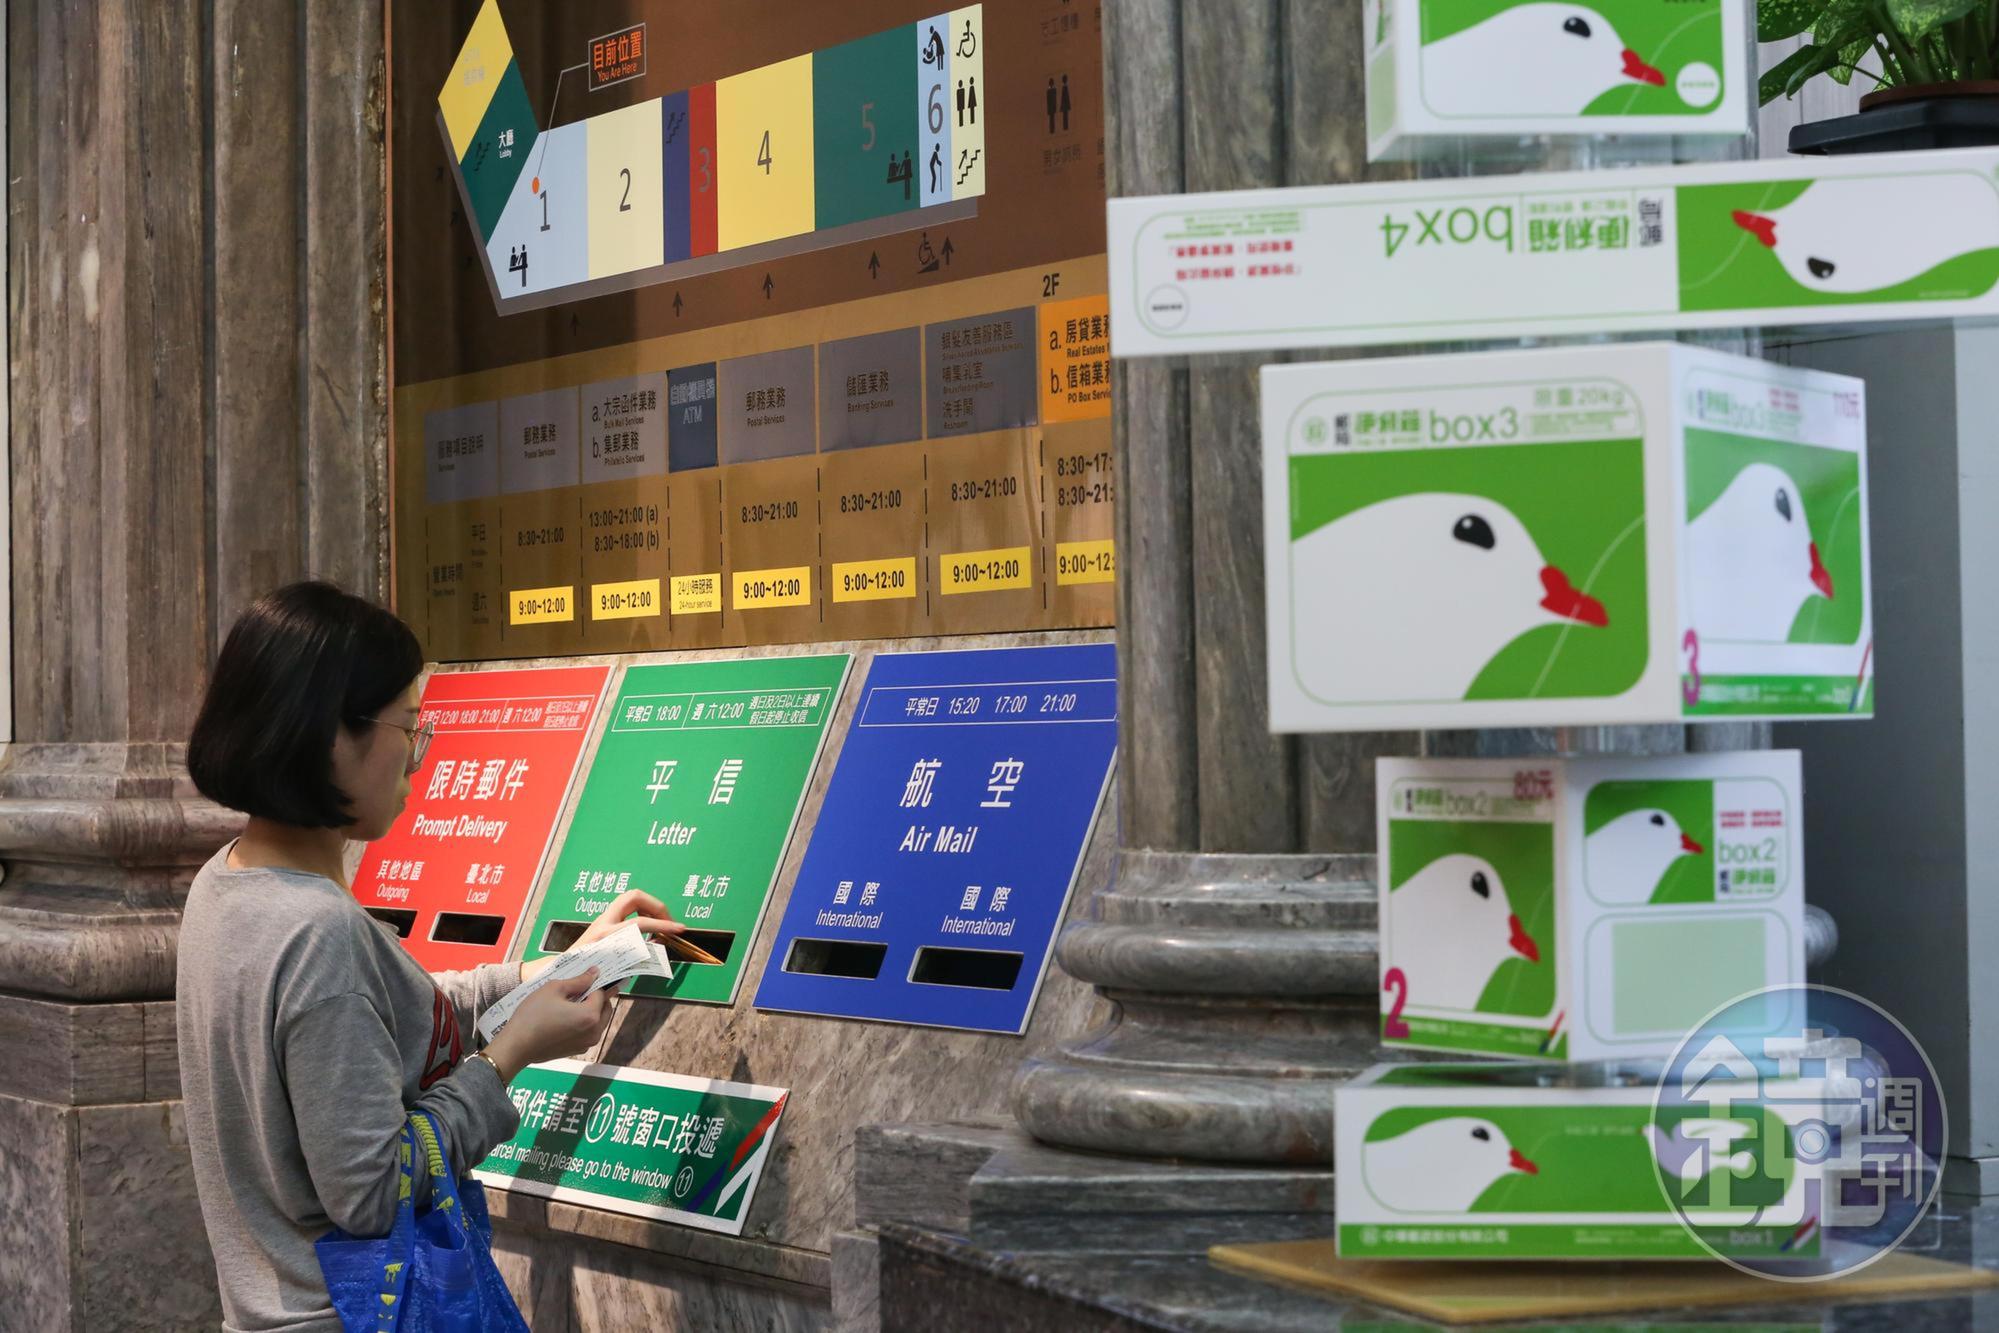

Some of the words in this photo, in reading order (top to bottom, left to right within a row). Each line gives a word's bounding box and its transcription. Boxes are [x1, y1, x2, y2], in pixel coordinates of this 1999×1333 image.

[593, 31, 642, 70] 目前位置
[597, 69, 608, 82] You
[609, 67, 621, 78] Are
[621, 63, 637, 75] Here
[927, 83, 944, 134] 6
[861, 102, 876, 151] 5
[757, 130, 772, 175] 4
[698, 147, 712, 192] 3
[619, 168, 632, 212] 2
[538, 189, 551, 232] 1
[1379, 205, 1515, 259] box4
[1528, 214, 1631, 254] 便利箱
[1043, 272, 1060, 297] 2F
[1049, 330, 1061, 351] a.
[1067, 346, 1081, 358] Real
[847, 369, 889, 397] 儲匯業務
[1050, 368, 1062, 394] b.
[592, 405, 601, 422] a.
[604, 390, 656, 417] 大宗函件業務
[746, 386, 786, 412] 郵務業務
[1068, 392, 1078, 403] PO
[1079, 390, 1091, 402] Box
[683, 405, 702, 424] ATM
[1429, 405, 1519, 443] box3
[523, 423, 556, 446] 郵務業務
[592, 436, 601, 459] b.
[604, 431, 639, 455] 集郵業務
[951, 476, 1016, 502] 8:30~21:00
[742, 501, 798, 523] 8:30~21:00
[841, 490, 902, 513] 8:30~21:00
[589, 506, 643, 528] 13:00~21:00
[646, 505, 658, 525] (a)
[518, 527, 564, 546] 8:30~21:00
[594, 532, 644, 552] 8:30~18:00
[646, 531, 659, 550] (b)
[844, 570, 904, 592] 9:00~12:00
[953, 560, 1019, 583] 9:00~12:00
[601, 591, 651, 610] 9:00~12:00
[744, 579, 800, 599] 9:00~12:00
[518, 597, 565, 616] 9:00~12:00
[1682, 628, 1700, 706] 3
[479, 708, 500, 723] 21:00
[521, 707, 542, 722] 12:00
[625, 705, 653, 723] 平常日
[655, 705, 681, 721] 18:00
[718, 702, 744, 719] 12:00
[905, 697, 940, 717] 平常日
[948, 696, 980, 715] 15:20
[994, 695, 1028, 713] 17:00
[1040, 693, 1077, 712] 21:00
[425, 758, 529, 801] 限時郵件
[411, 814, 456, 842] Prompt
[456, 815, 508, 844] Delivery
[647, 820, 697, 845] Letter
[899, 825, 931, 852] Air
[933, 826, 978, 854] Mail
[1719, 837, 1776, 864] box2
[376, 860, 425, 882] 其他地區
[464, 863, 505, 885] 臺北市
[573, 870, 631, 894] 其他地區
[377, 882, 410, 902] Outgoing
[466, 887, 490, 904] Local
[682, 874, 731, 898] 臺北市
[833, 880, 880, 906] 國際
[575, 896, 614, 916] Outgoin
[684, 902, 713, 919] Local
[960, 886, 1011, 912] 國際
[816, 908, 883, 929] International
[941, 915, 1016, 937] International
[1384, 967, 1410, 1039] 2
[488, 1141, 513, 1160] arcel
[514, 1145, 550, 1171] mailing
[550, 1150, 583, 1173] please
[583, 1160, 599, 1180] go
[600, 1160, 611, 1178] to
[613, 1162, 630, 1182] the
[631, 1166, 672, 1190] window
